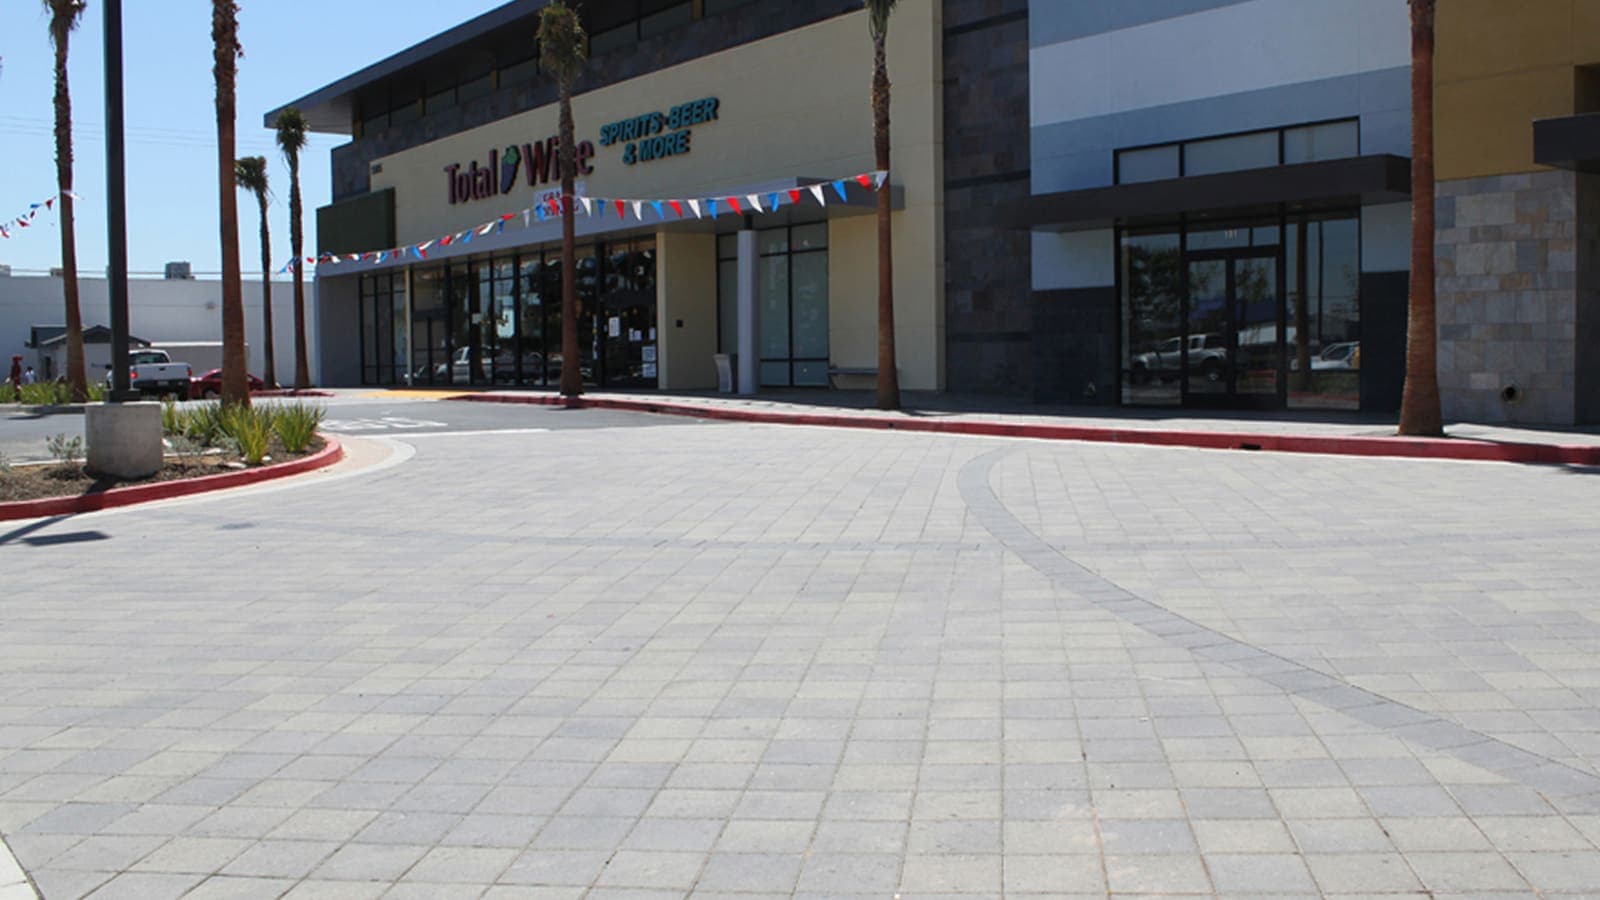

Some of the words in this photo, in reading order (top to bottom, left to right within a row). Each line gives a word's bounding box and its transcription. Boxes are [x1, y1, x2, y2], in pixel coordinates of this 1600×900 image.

[599, 111, 663, 146] SPIRITS
[668, 97, 719, 130] BEER
[444, 147, 499, 205] Total
[522, 136, 594, 186] Wie
[623, 143, 637, 165] &
[638, 129, 691, 162] MORE
